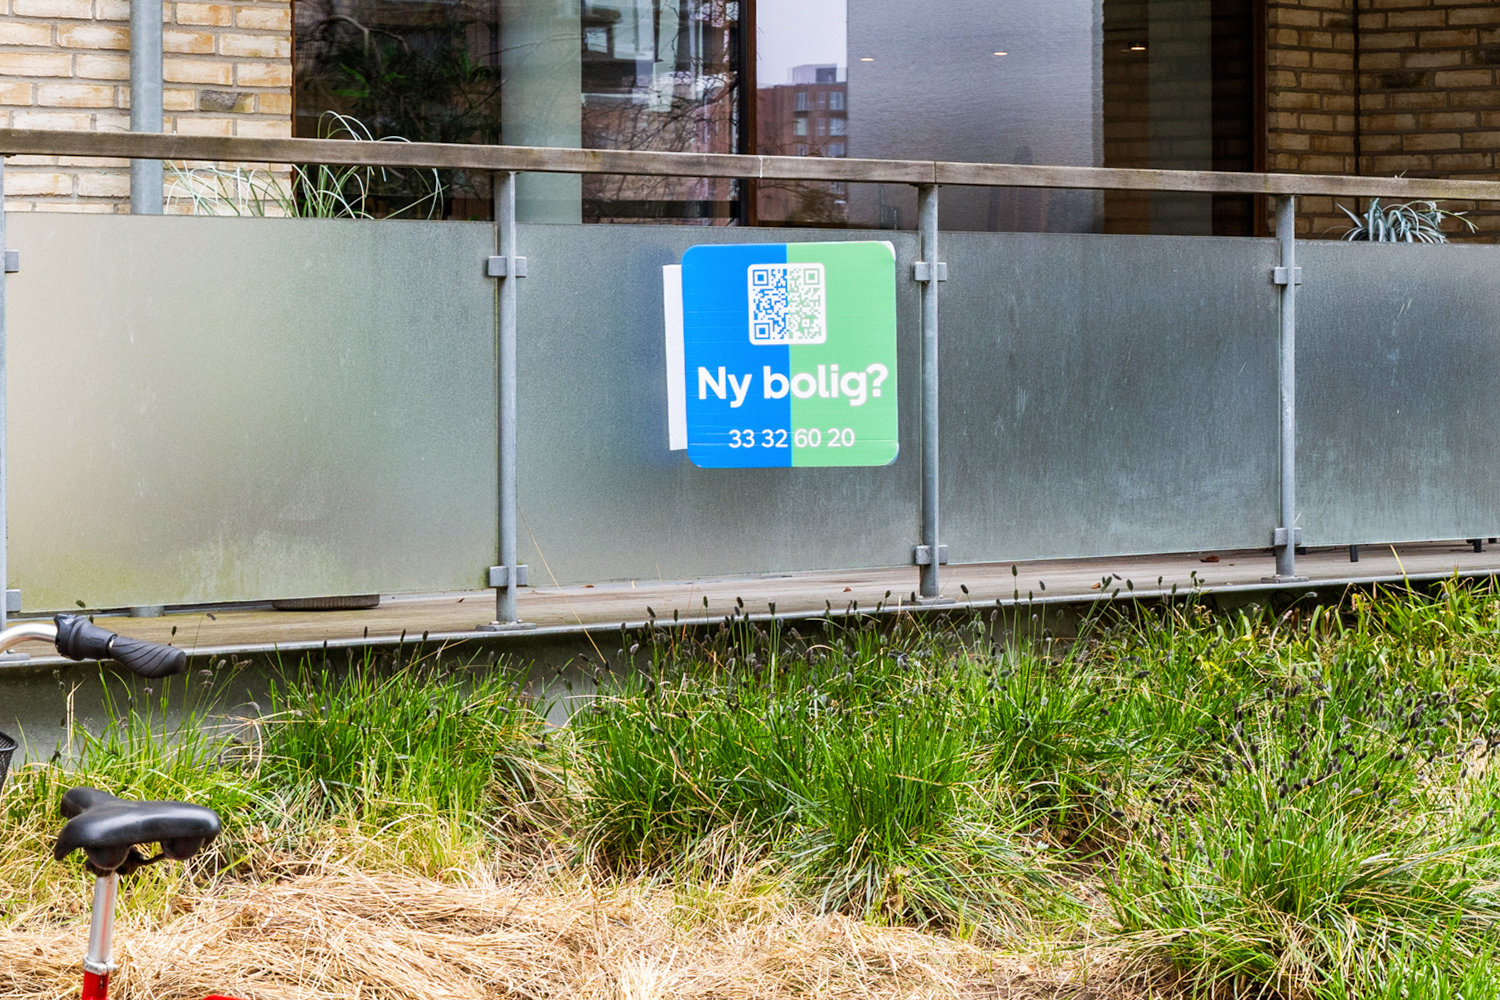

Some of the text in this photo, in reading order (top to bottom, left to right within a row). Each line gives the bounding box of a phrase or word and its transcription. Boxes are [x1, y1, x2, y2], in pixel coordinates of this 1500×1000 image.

[698, 363, 888, 408] Ny bolig?
[728, 428, 855, 448] 33 32 60 20
